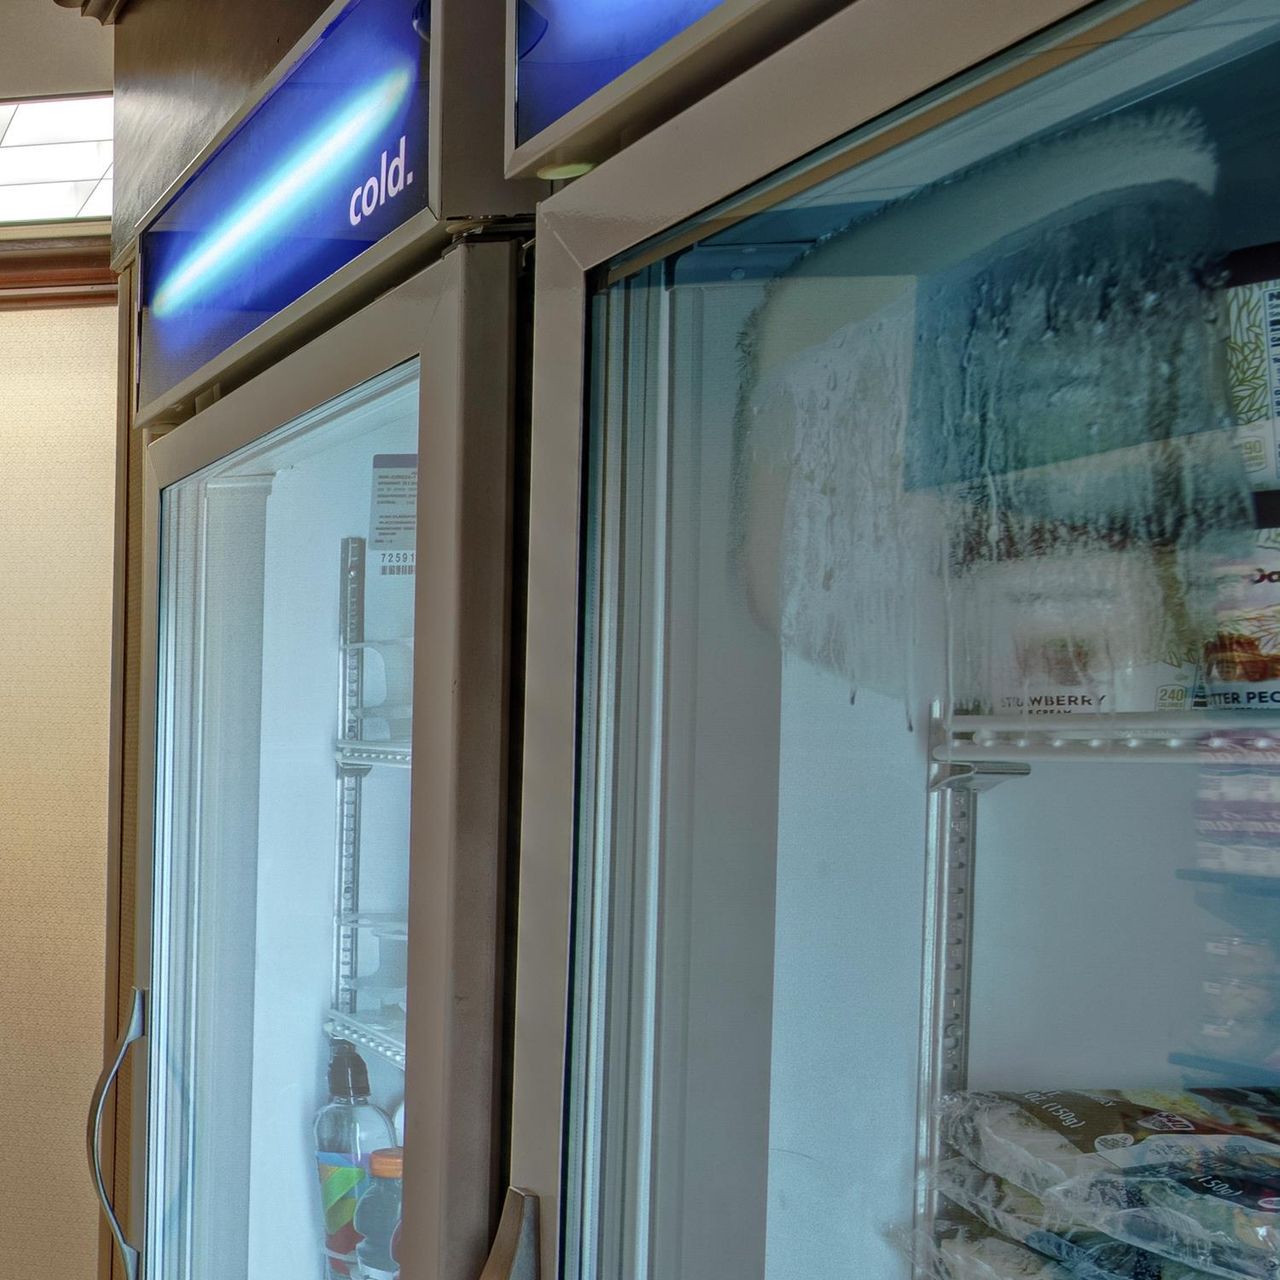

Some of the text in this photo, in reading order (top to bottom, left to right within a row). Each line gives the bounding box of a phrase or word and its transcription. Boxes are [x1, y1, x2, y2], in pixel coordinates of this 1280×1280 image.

[349, 137, 413, 226] cold.
[1160, 689, 1183, 702] 240
[1041, 1102, 1085, 1128] (150g)
[1190, 1175, 1244, 1197] (150g)
